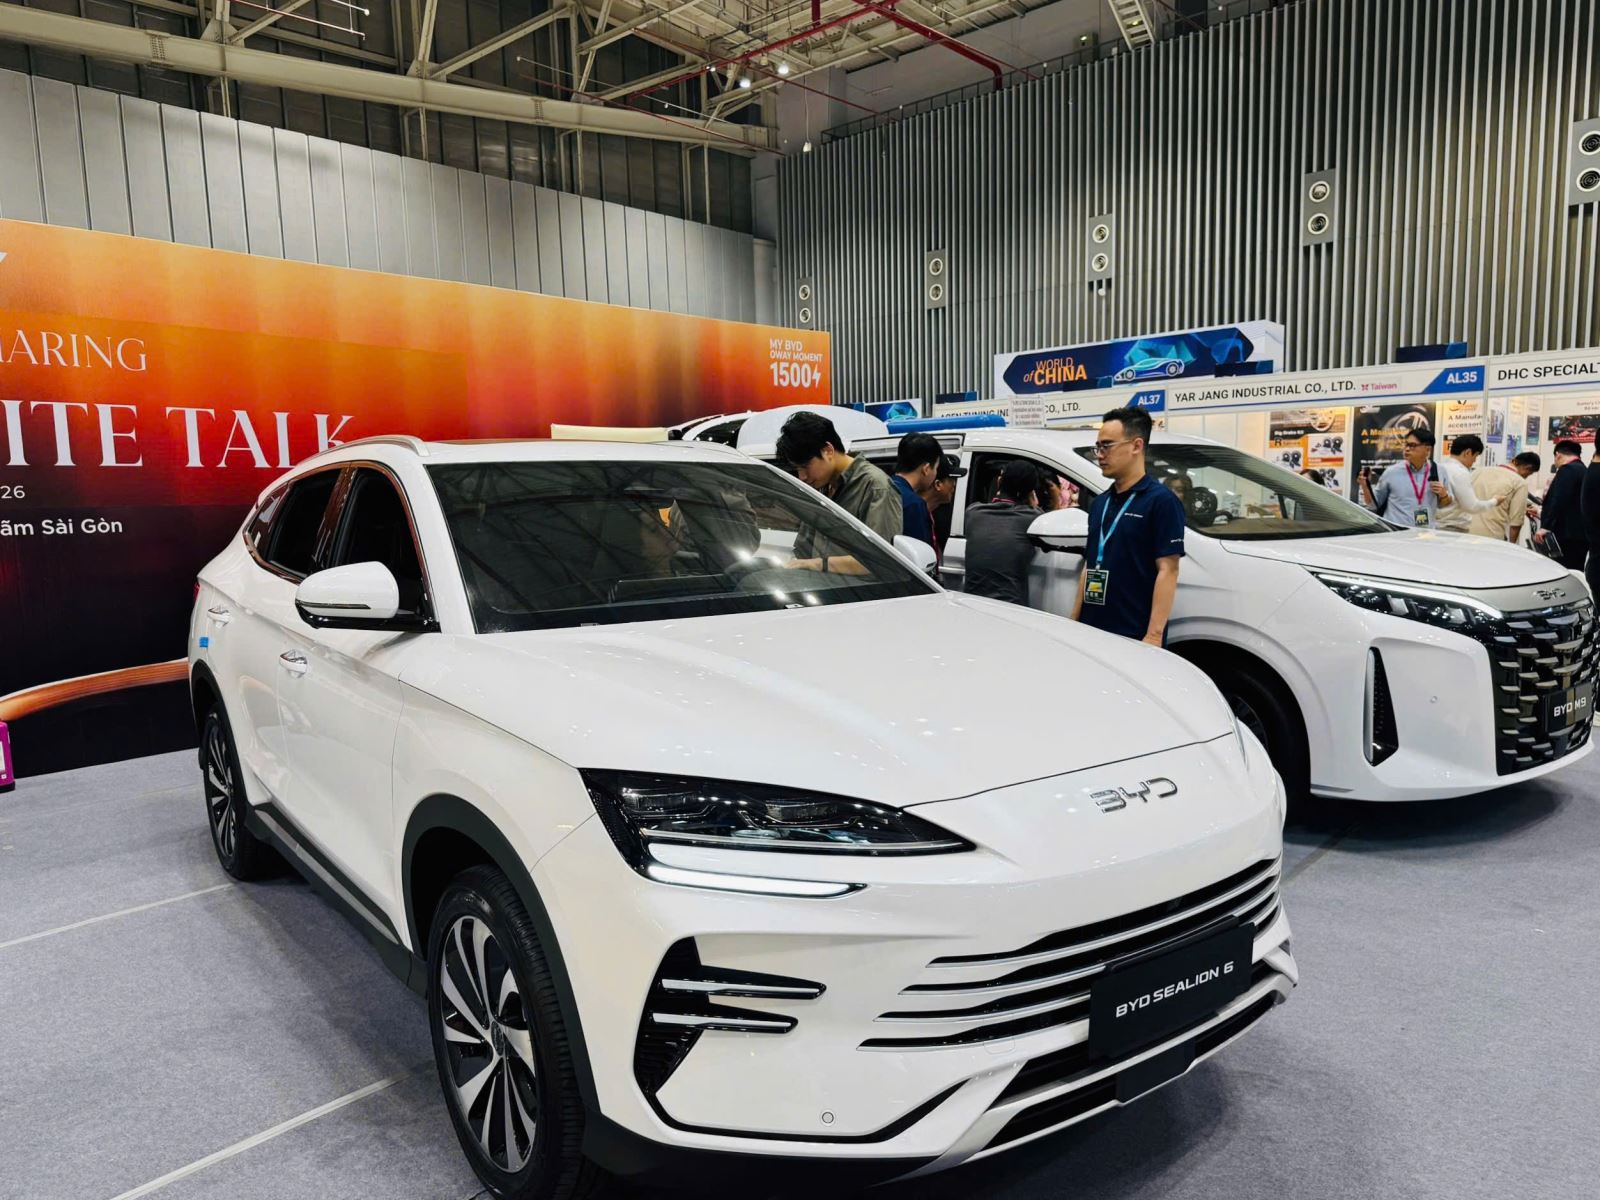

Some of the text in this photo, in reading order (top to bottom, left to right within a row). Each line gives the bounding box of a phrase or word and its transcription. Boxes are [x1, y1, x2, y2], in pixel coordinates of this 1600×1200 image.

[0, 329, 147, 372] ARING
[769, 338, 803, 351] MY BYD
[770, 350, 823, 362] OWAY MOMENT
[1036, 357, 1073, 370] WORLD
[770, 362, 812, 388] 1500
[1023, 364, 1088, 385] of CHINA
[1446, 371, 1478, 385] AL35
[1498, 368, 1529, 381] DHC
[1175, 380, 1357, 403] YAR JANG INDUSTRIAL CO., LTD.
[1370, 382, 1398, 391] Taiwan
[1062, 402, 1081, 412] LTD.
[1138, 394, 1161, 406] AL37
[0, 400, 354, 468] ITE TALK
[41, 518, 74, 535] Sài
[80, 517, 123, 534] Gòn
[1553, 697, 1587, 717] BYD M9
[1090, 776, 1177, 813] BYD
[1115, 960, 1234, 1018] BYD SEALION 6
